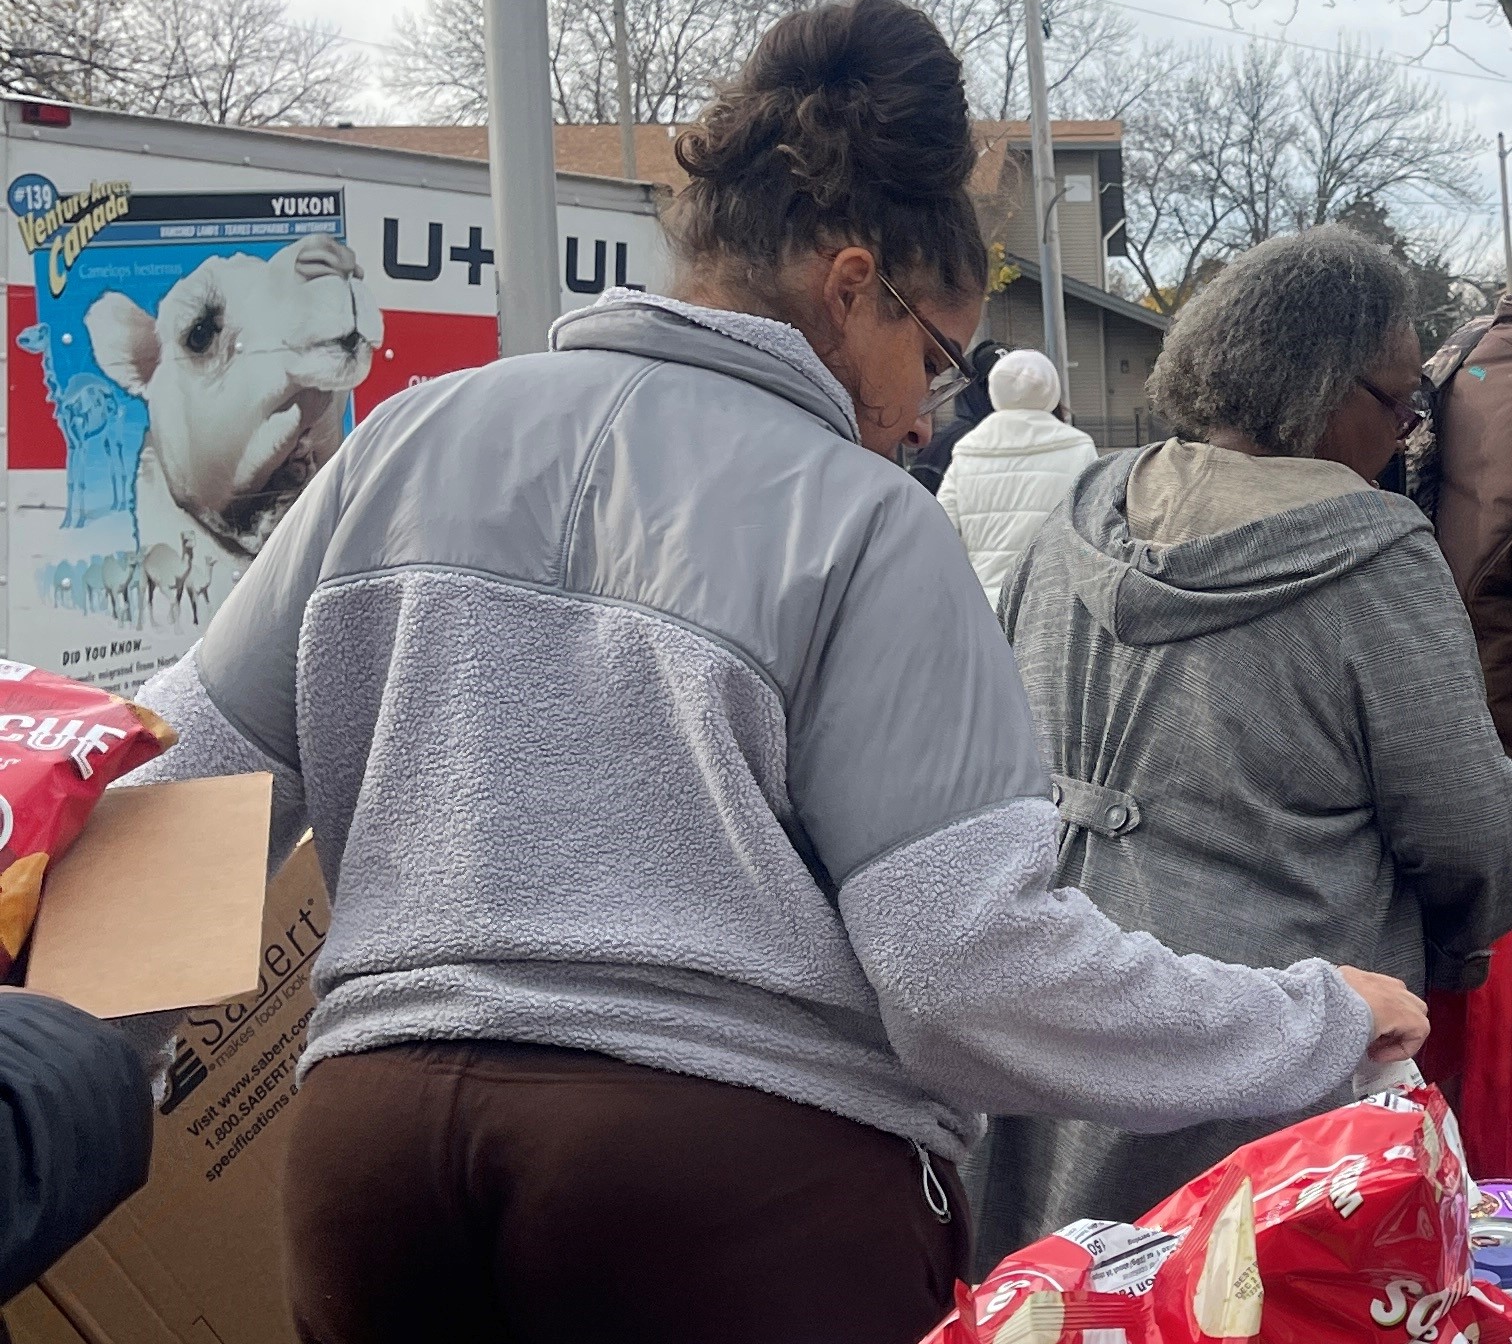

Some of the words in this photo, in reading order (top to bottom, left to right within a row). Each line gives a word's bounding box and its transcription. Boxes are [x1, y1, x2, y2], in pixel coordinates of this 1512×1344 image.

[13, 185, 51, 210] #139
[271, 196, 336, 216] YUKON
[18, 191, 89, 254] Venture
[49, 194, 130, 295] Canada
[62, 651, 80, 666] DID
[85, 646, 106, 662] YOU
[215, 1027, 256, 1069] makes
[255, 1000, 283, 1029] food
[282, 972, 308, 1000] look
[186, 1105, 219, 1138] Visit
[217, 1006, 316, 1110] www.sabert.com
[205, 1095, 290, 1182] specifications
[1087, 1238, 1106, 1257] 150
[1232, 1267, 1256, 1289] BEST
[1235, 1281, 1252, 1300] DEC
